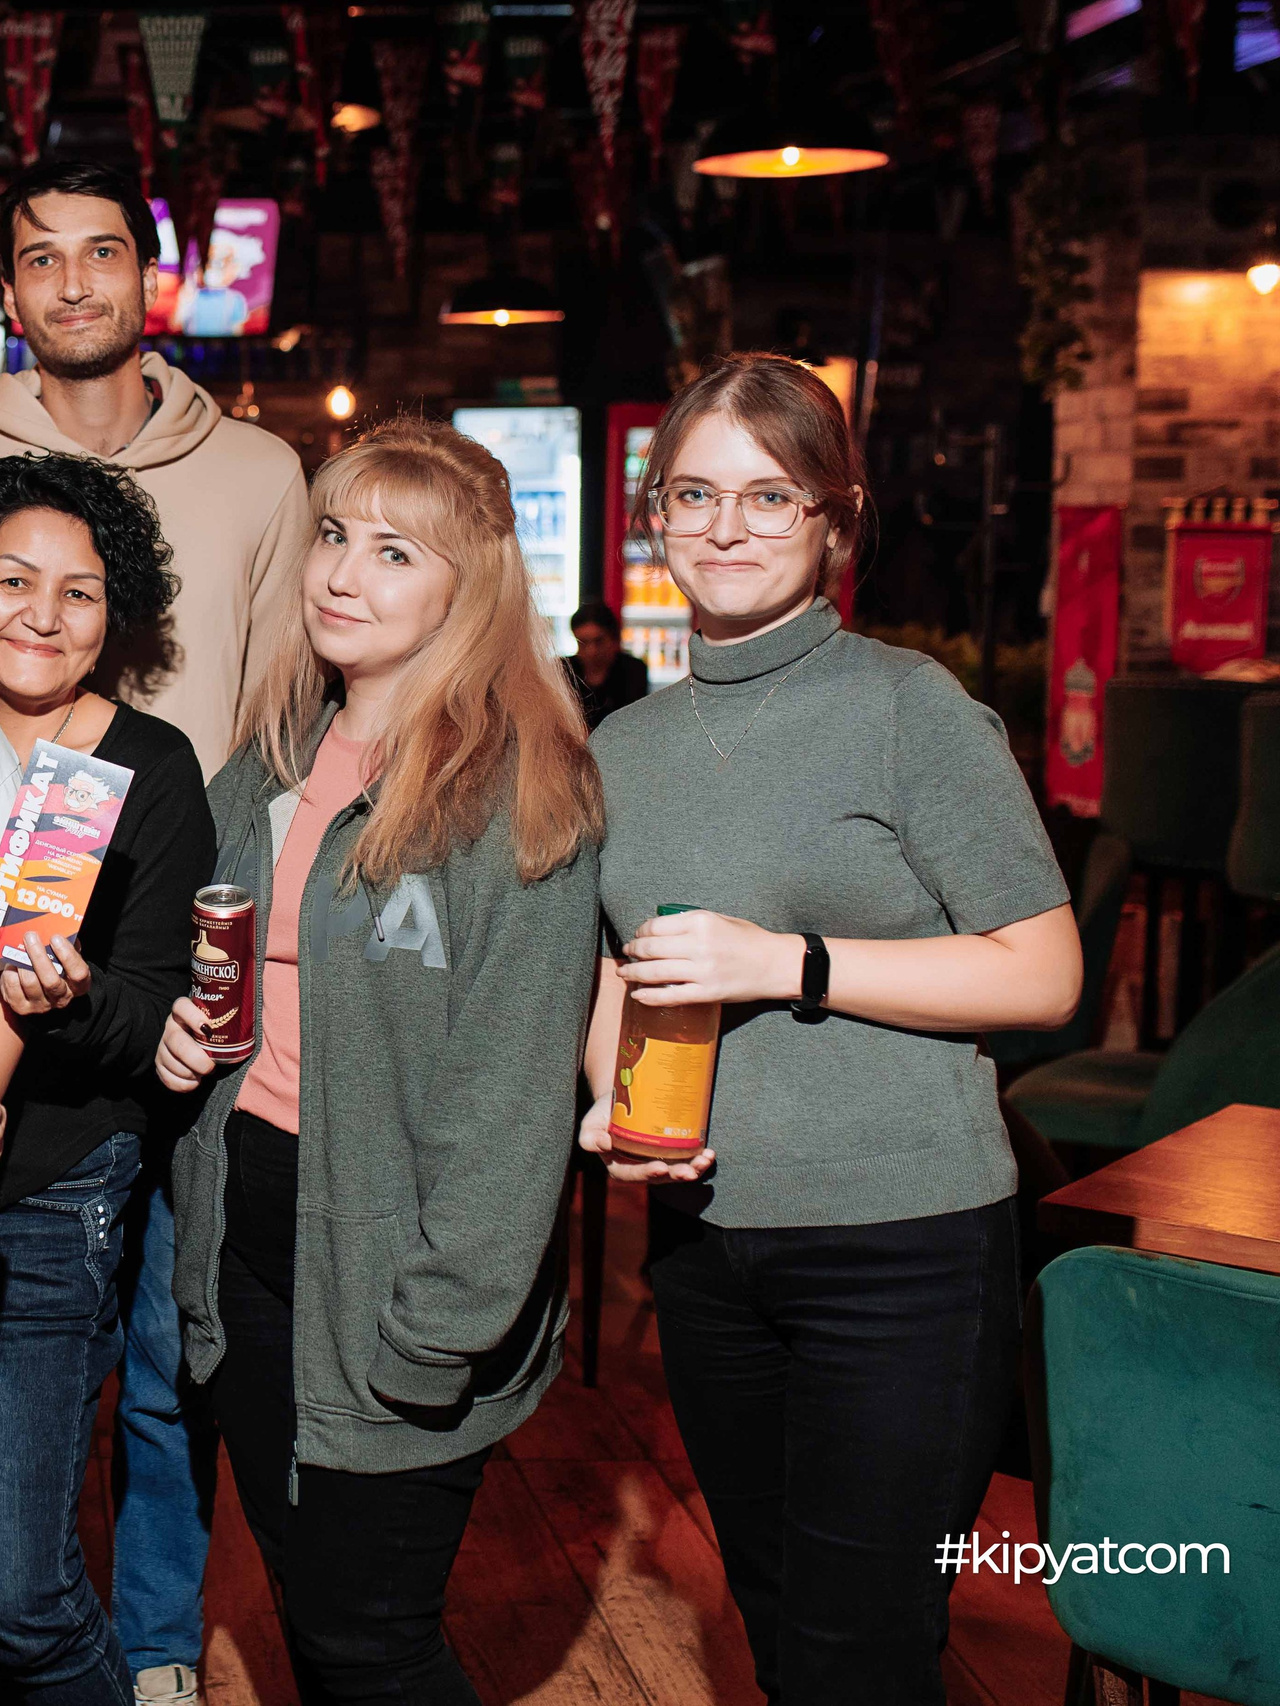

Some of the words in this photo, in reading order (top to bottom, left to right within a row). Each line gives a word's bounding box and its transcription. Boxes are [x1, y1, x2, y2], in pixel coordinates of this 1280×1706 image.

[17, 888, 37, 906] 13
[37, 895, 74, 918] 000
[46, 889, 68, 900] СУММУ
